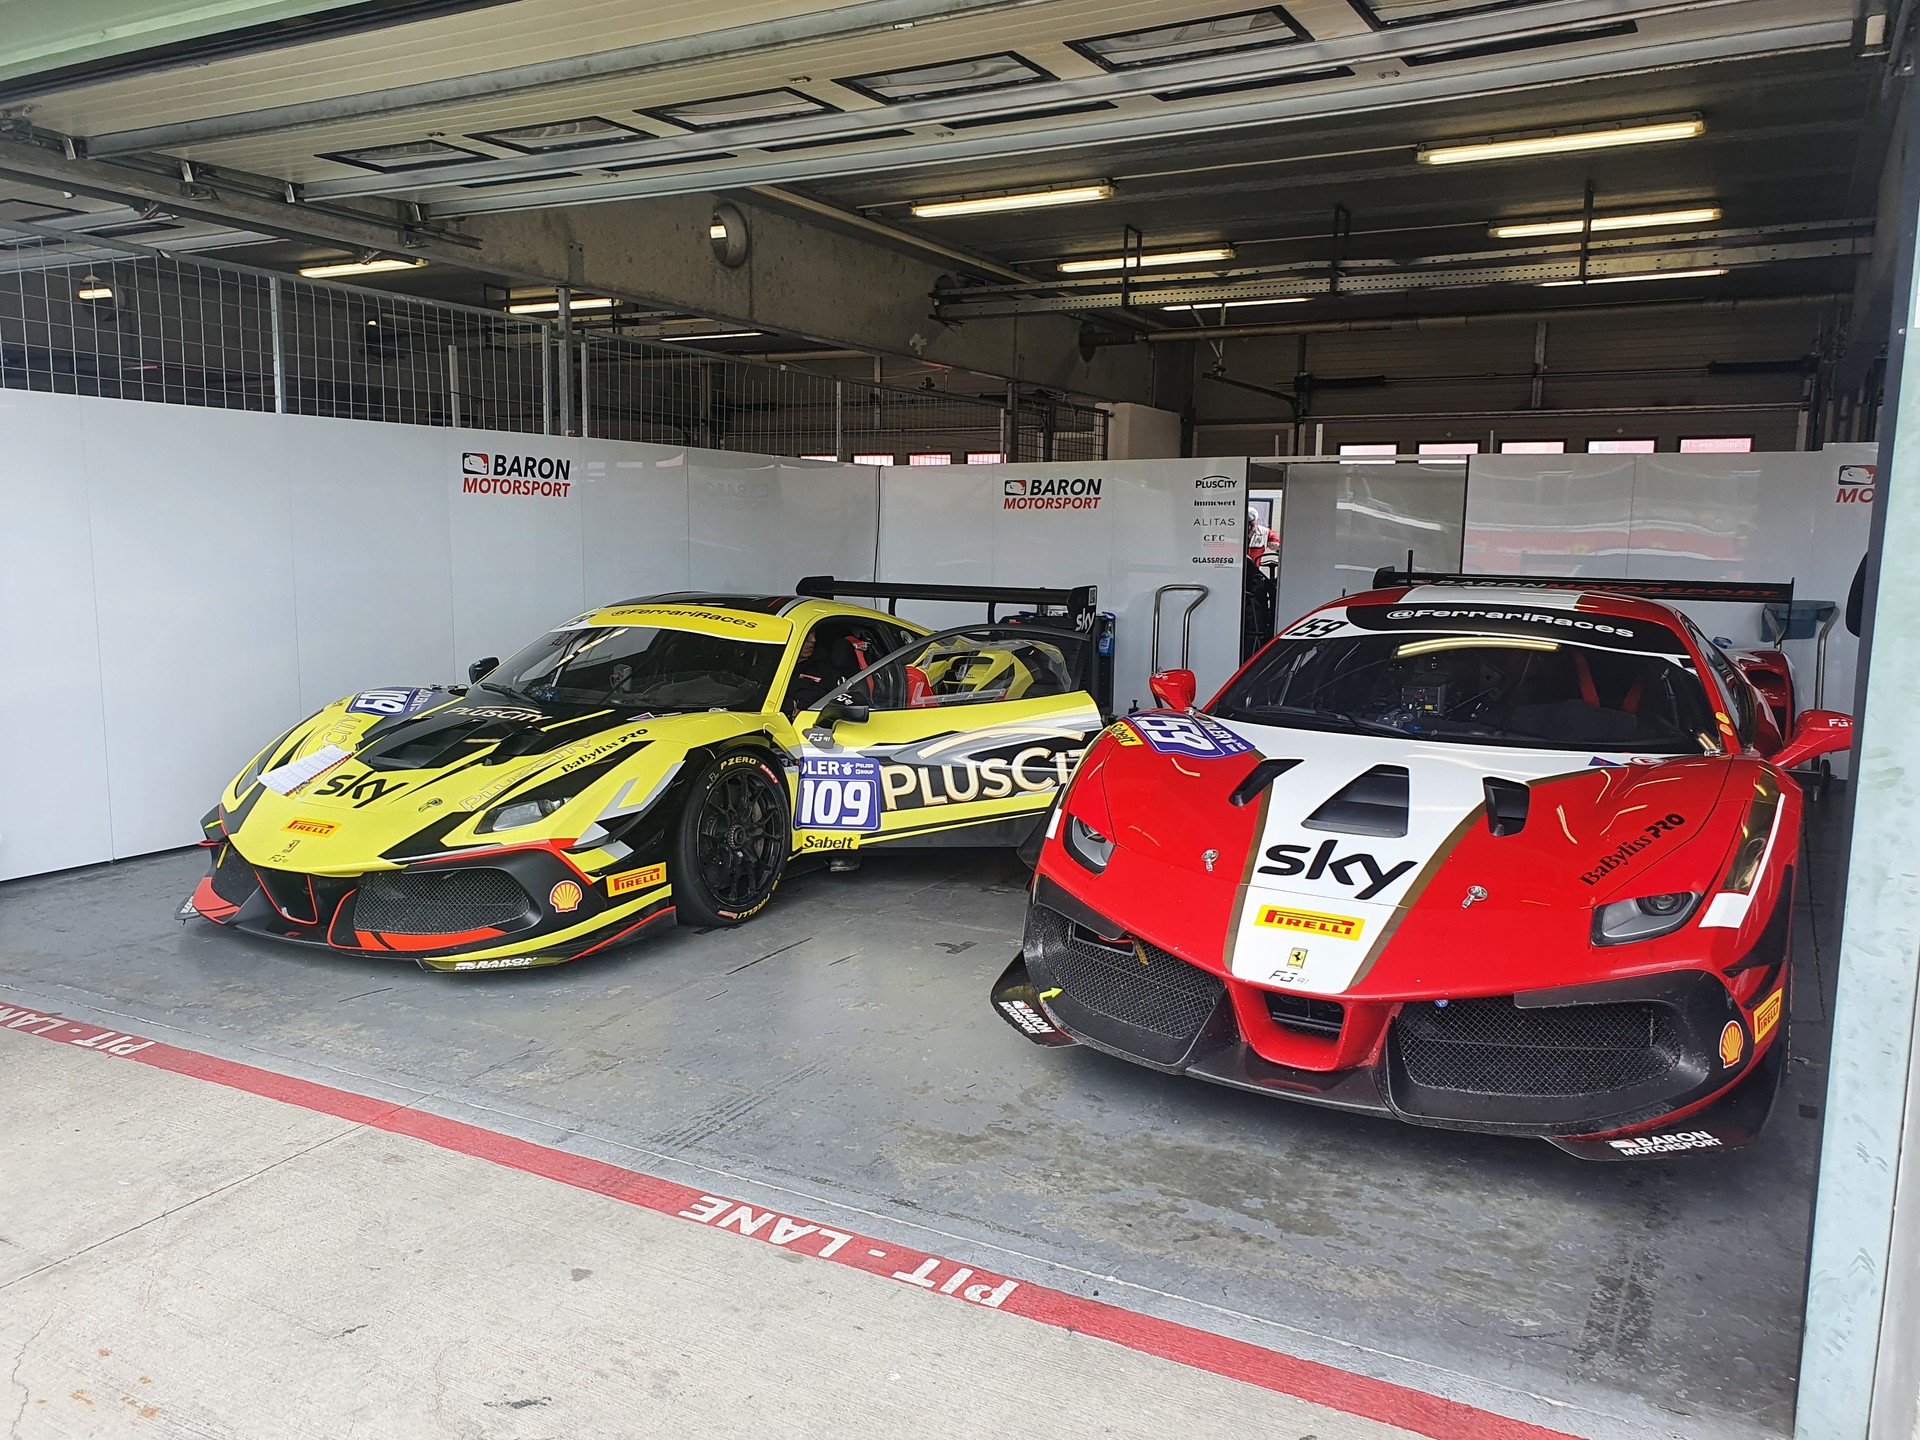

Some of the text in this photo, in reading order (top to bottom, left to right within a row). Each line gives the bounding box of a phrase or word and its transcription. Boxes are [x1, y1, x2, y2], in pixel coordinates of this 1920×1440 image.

[494, 454, 571, 481] BARON
[463, 477, 571, 498] MOTORSPORT
[1029, 478, 1102, 496] BARON
[1003, 496, 1102, 510] MOTORSPORT
[1193, 518, 1236, 527] ALITAS
[1203, 534, 1226, 542] CFC
[1191, 556, 1234, 564] GLASSRESQ
[610, 607, 759, 629] @FerrariRaces
[1075, 607, 1095, 635] sky
[1285, 618, 1347, 638] 159
[1386, 609, 1635, 638] @FerrariRaces
[618, 728, 649, 743] PRO
[1132, 716, 1216, 751] 159
[313, 770, 410, 809] sky
[801, 779, 871, 826] 109
[287, 820, 335, 835] PIRELLI
[1645, 813, 1686, 839] PRO
[803, 835, 854, 849] Sabelt
[613, 866, 661, 891] PIRELLI
[1257, 839, 1419, 900] sky
[1264, 909, 1355, 935] PIRELLI
[998, 1001, 1041, 1035] MOTORSPORT
[1017, 1007, 1056, 1034] BARON
[1756, 996, 1780, 1036] PIRELLI
[71, 1031, 156, 1056] PIT
[1620, 1137, 1724, 1157] MOTORSPORT
[1634, 1130, 1715, 1147] BARON
[678, 1195, 855, 1259] LANE
[891, 1258, 1020, 1309] PIT
